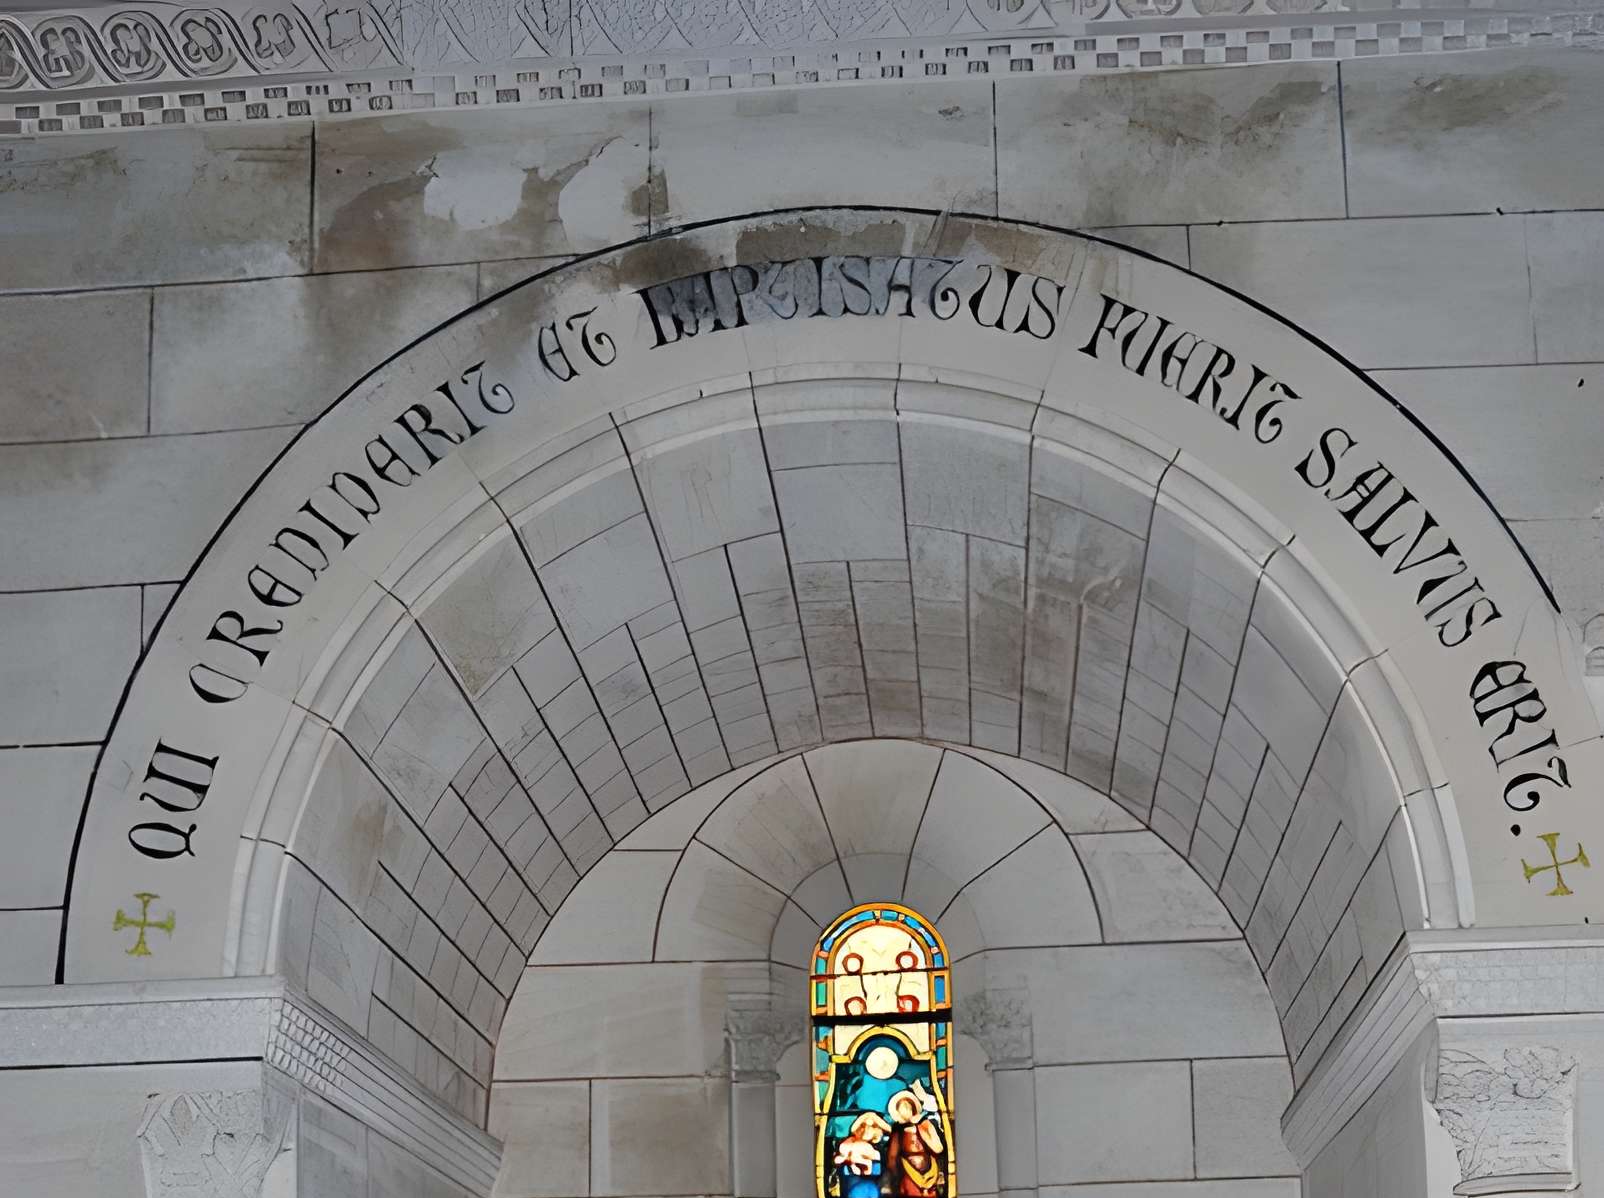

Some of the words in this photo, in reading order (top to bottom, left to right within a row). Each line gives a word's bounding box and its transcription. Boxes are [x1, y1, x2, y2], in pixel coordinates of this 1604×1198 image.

[128, 738, 219, 858] QUI
[189, 360, 515, 703] CREDIDERIT
[537, 305, 617, 382] ET
[1077, 293, 1302, 444] FUERIT
